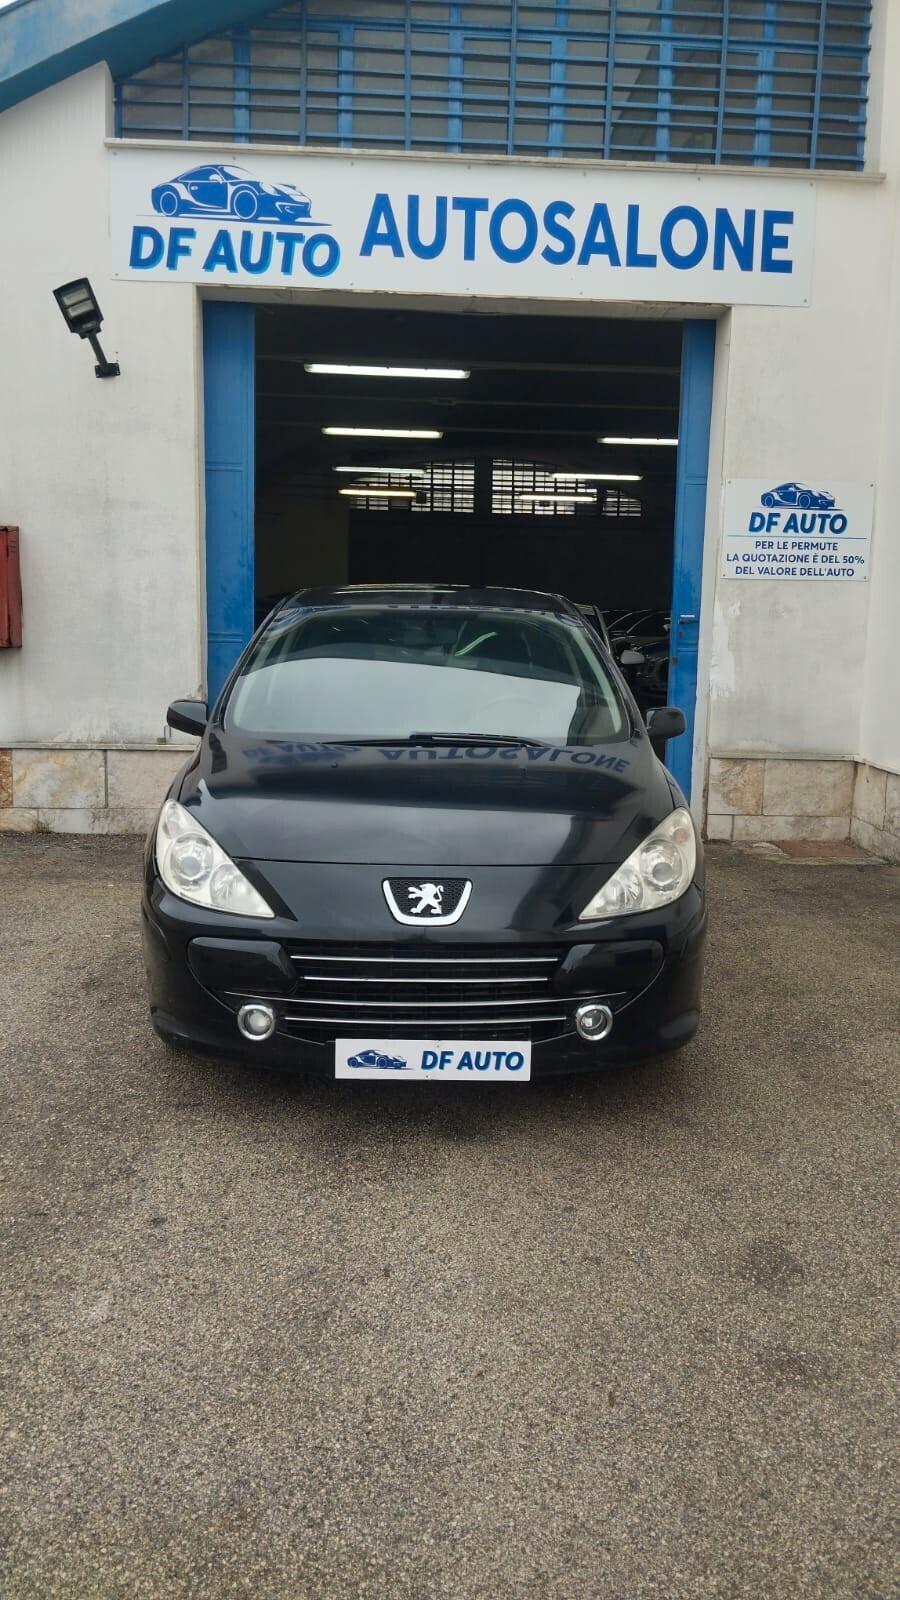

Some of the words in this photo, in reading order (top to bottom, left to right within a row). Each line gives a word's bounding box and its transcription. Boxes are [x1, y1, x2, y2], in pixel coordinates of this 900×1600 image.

[360, 193, 793, 273] AUTOSALONE
[129, 225, 195, 270] DF
[202, 229, 340, 277] AUTO
[749, 512, 780, 533] DF
[783, 513, 847, 534] AUTO
[755, 541, 774, 550] PER
[777, 541, 788, 550] LE
[792, 542, 838, 551] PERMUTE
[726, 553, 739, 562] LA
[742, 554, 809, 563] QUOTAZIONE
[812, 553, 817, 563] È
[821, 555, 840, 563] DEL
[843, 556, 865, 564] 50%
[735, 566, 755, 575] DEL
[758, 567, 797, 575] VALORE
[800, 568, 854, 576] DELL'AUTO
[421, 1050, 454, 1070] DF
[456, 1051, 525, 1071] AUTO
